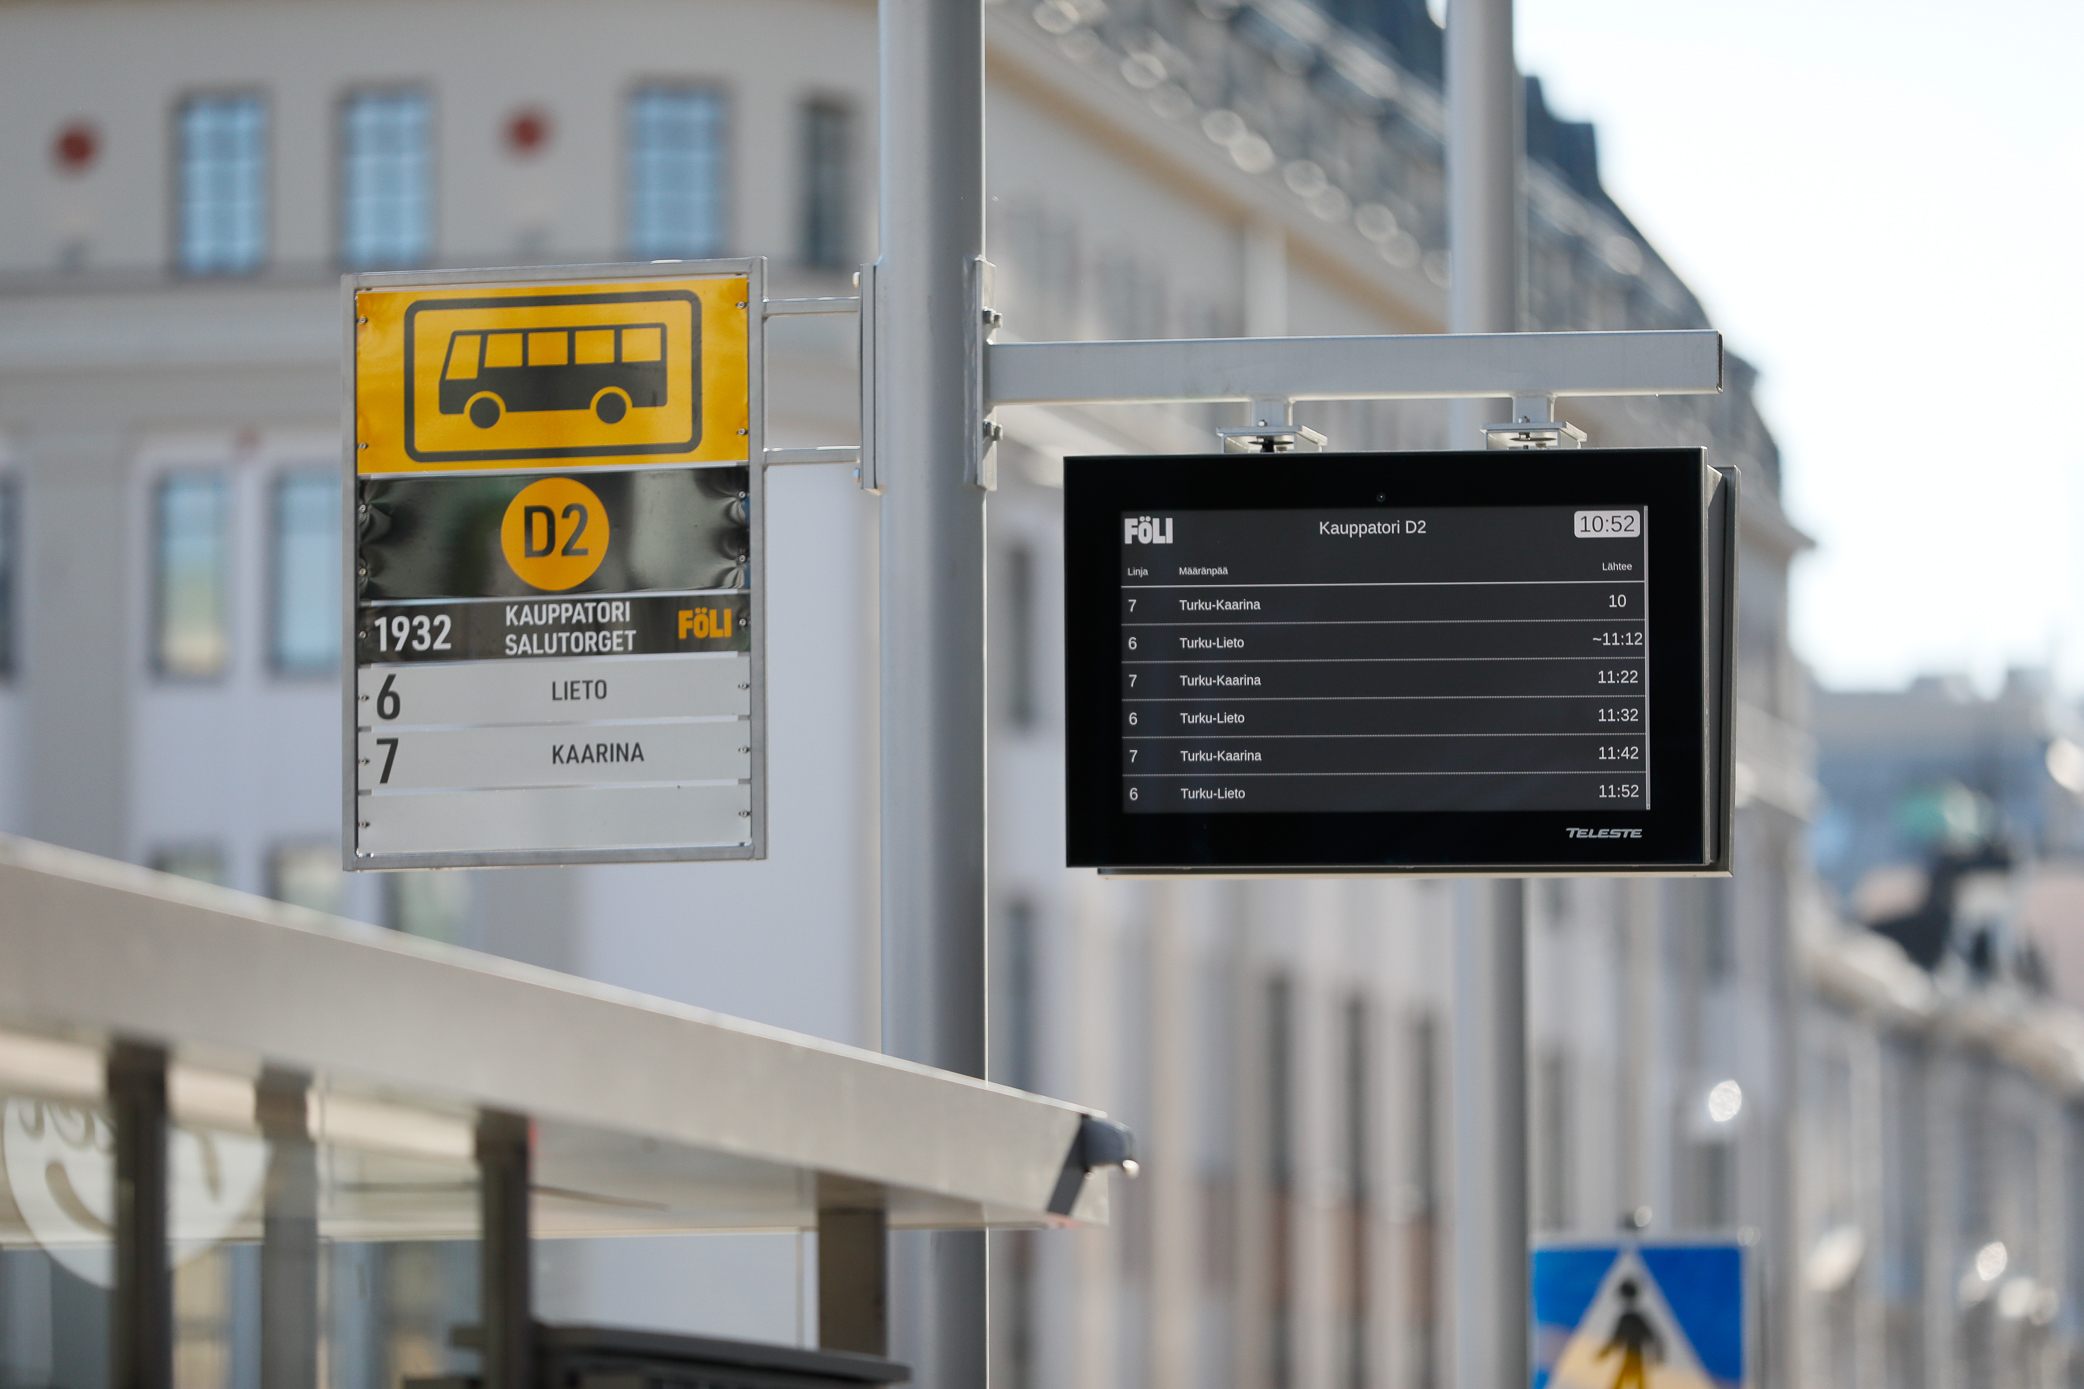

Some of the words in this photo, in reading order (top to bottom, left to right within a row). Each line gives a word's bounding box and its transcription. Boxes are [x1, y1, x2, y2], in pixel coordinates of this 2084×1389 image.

[523, 503, 588, 558] D2
[1124, 515, 1174, 545] FÖLI
[1319, 519, 1400, 538] Kauppatori
[1405, 519, 1427, 534] D2
[1580, 514, 1635, 533] 10:52
[1127, 566, 1149, 578] Linja
[1178, 566, 1229, 577] Määränpää
[1602, 561, 1633, 571] Lähtee
[505, 601, 631, 624] KAUPPATORI
[1128, 598, 1137, 613] 7
[1179, 598, 1261, 611] Turku-Kaarina
[1608, 594, 1627, 608] 10
[678, 606, 733, 640] FÖLI
[374, 614, 452, 652] 1932
[505, 630, 637, 655] SALUTORGET
[1128, 636, 1138, 651] 6
[1179, 636, 1245, 649] Turku-Lieto
[1128, 674, 1138, 688] 7
[1179, 674, 1262, 687] Turku-Kaarina
[1598, 669, 1639, 684] 11:22
[376, 673, 401, 721] 6
[551, 679, 608, 701] LIETO
[1128, 711, 1138, 726] 6
[1179, 711, 1245, 724] Turku-Lieto
[1598, 708, 1639, 722] 11:32
[376, 737, 399, 785] 7
[552, 742, 645, 765] KAARINA
[1129, 749, 1138, 763] 7
[1180, 749, 1262, 762] Turku-Kaarina
[1598, 745, 1639, 760] 11:42
[1129, 787, 1139, 801] 6
[1180, 787, 1246, 799] Turku-Lieto
[1599, 784, 1639, 798] 11:52
[1565, 827, 1643, 839] TELESTE
